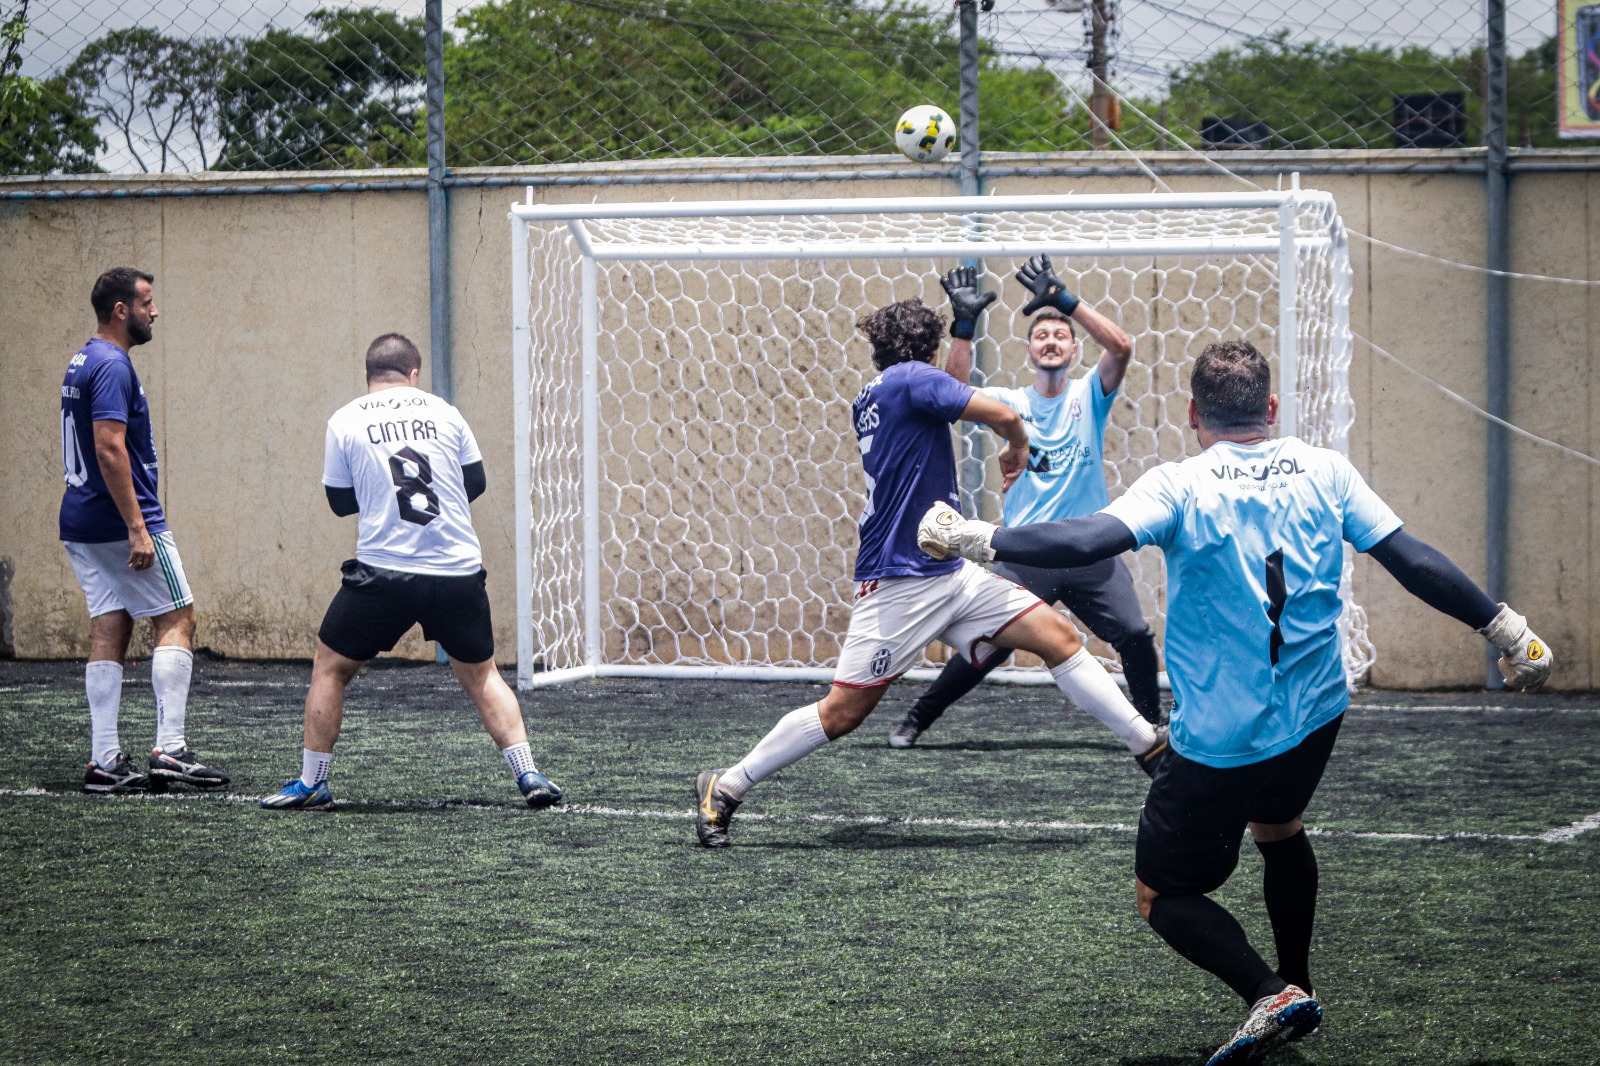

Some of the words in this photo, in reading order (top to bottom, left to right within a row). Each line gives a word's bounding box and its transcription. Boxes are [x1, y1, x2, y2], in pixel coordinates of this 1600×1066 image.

[359, 401, 386, 411] VIA
[403, 397, 430, 407] SOL
[366, 419, 438, 444] CINTRA
[1211, 465, 1249, 480] VIA
[1270, 458, 1306, 475] SOL
[388, 446, 441, 526] 8
